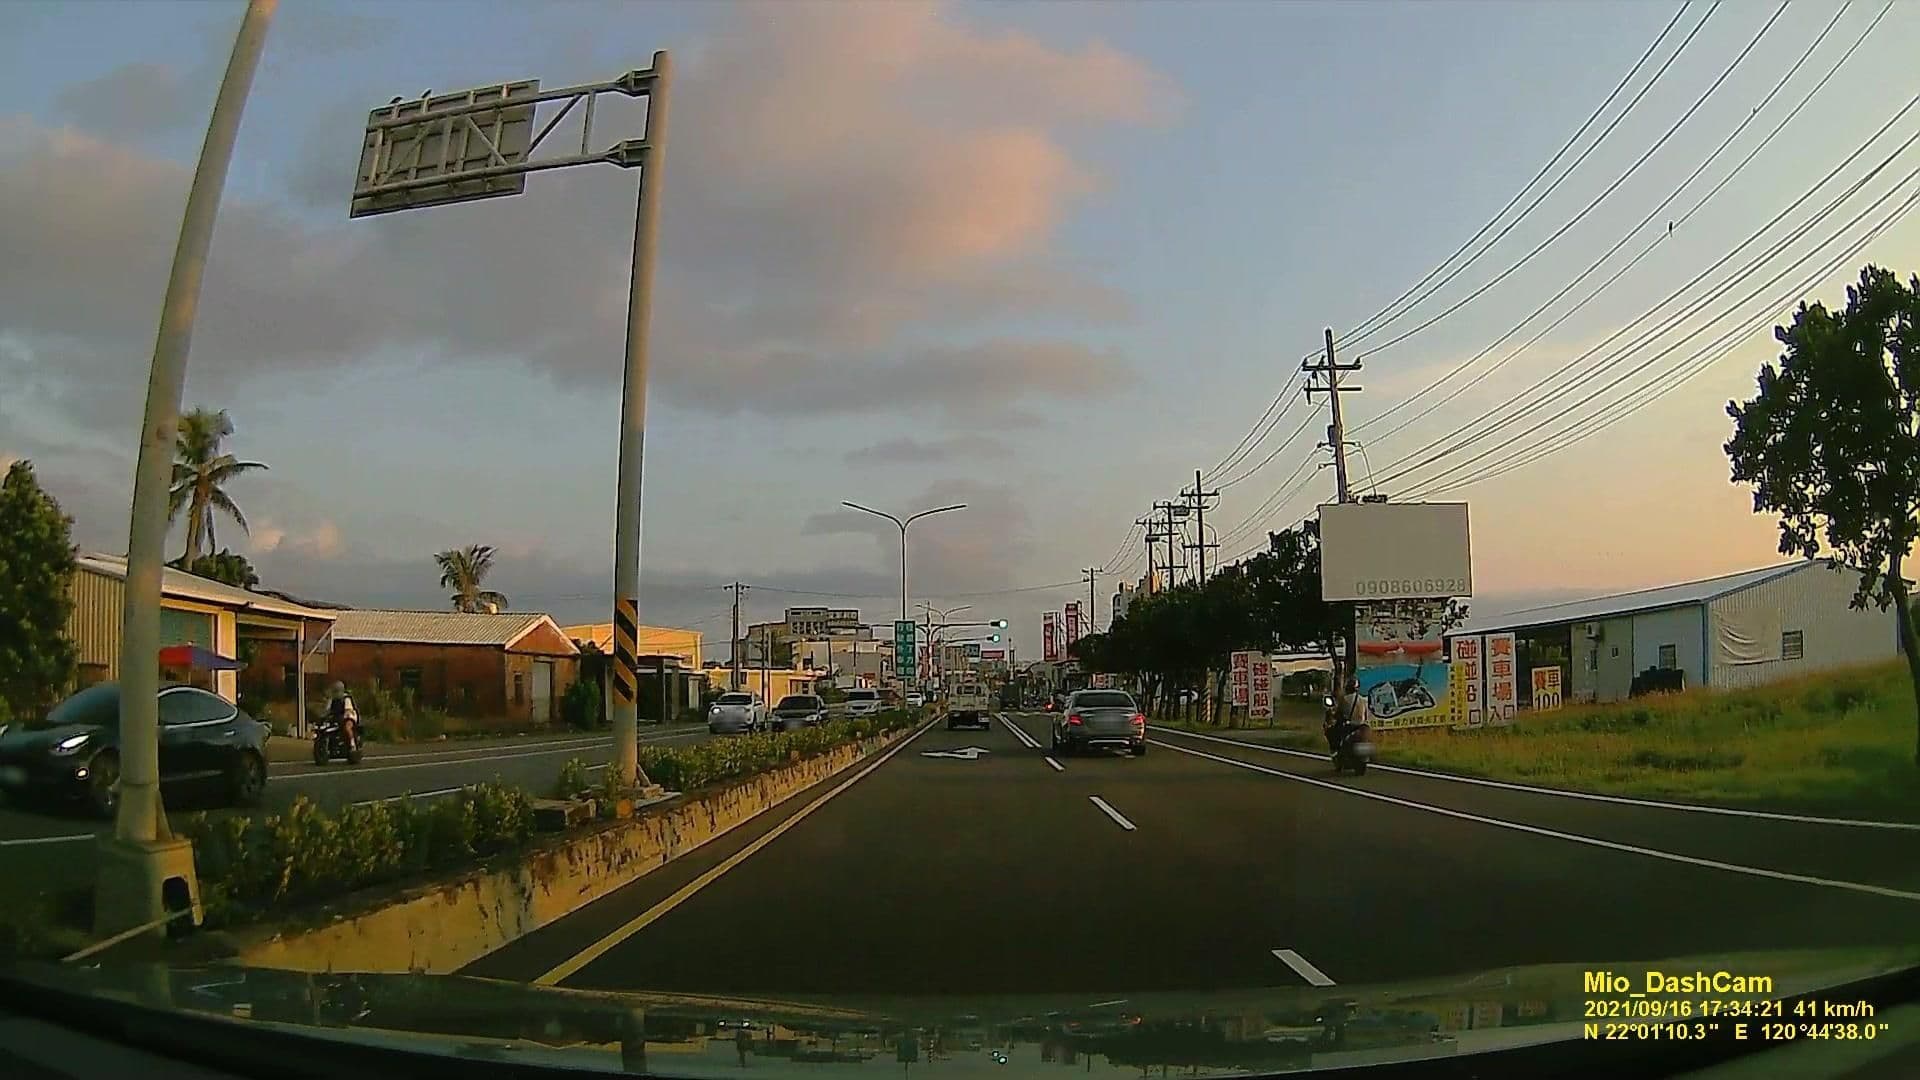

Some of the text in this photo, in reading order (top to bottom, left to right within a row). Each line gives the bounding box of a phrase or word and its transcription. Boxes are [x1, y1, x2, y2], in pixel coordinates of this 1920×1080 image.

[1356, 578, 1466, 595] 0908606928
[1491, 638, 1512, 701] 賽車場
[1535, 692, 1560, 709] 100
[1489, 704, 1515, 722] 入口
